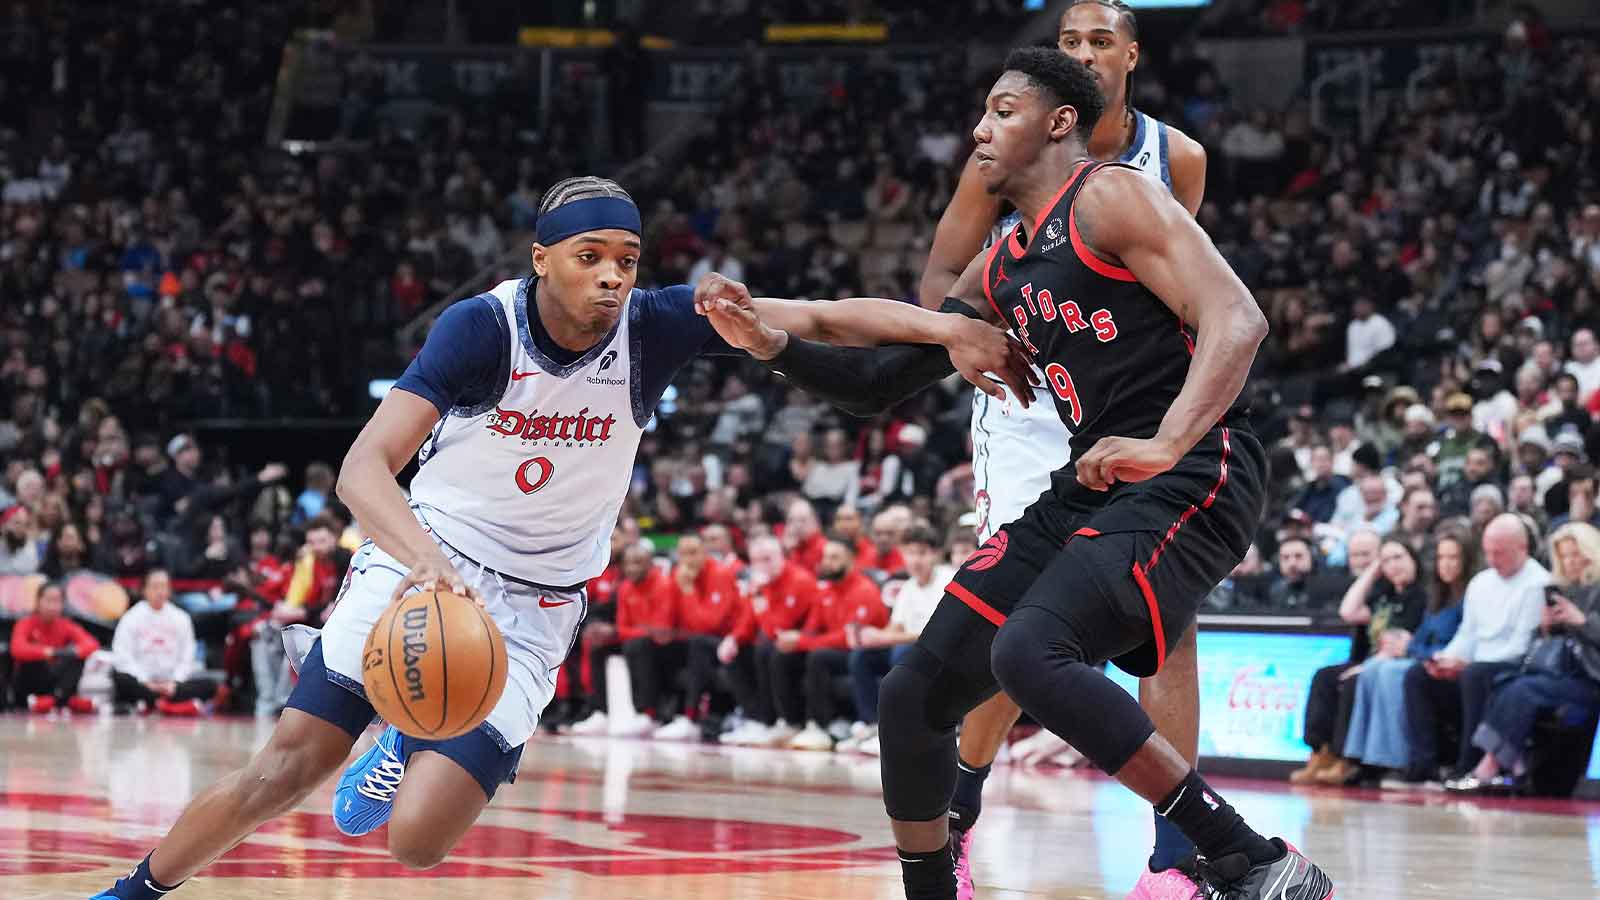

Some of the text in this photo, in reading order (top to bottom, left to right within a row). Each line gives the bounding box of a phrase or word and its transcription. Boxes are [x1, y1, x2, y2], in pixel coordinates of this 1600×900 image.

[1013, 282, 1118, 356] PTORS
[586, 376, 626, 386] Robinhood
[1045, 362, 1082, 427] 9
[486, 405, 616, 441] District
[514, 456, 555, 496] 0
[402, 605, 428, 701] Wilson
